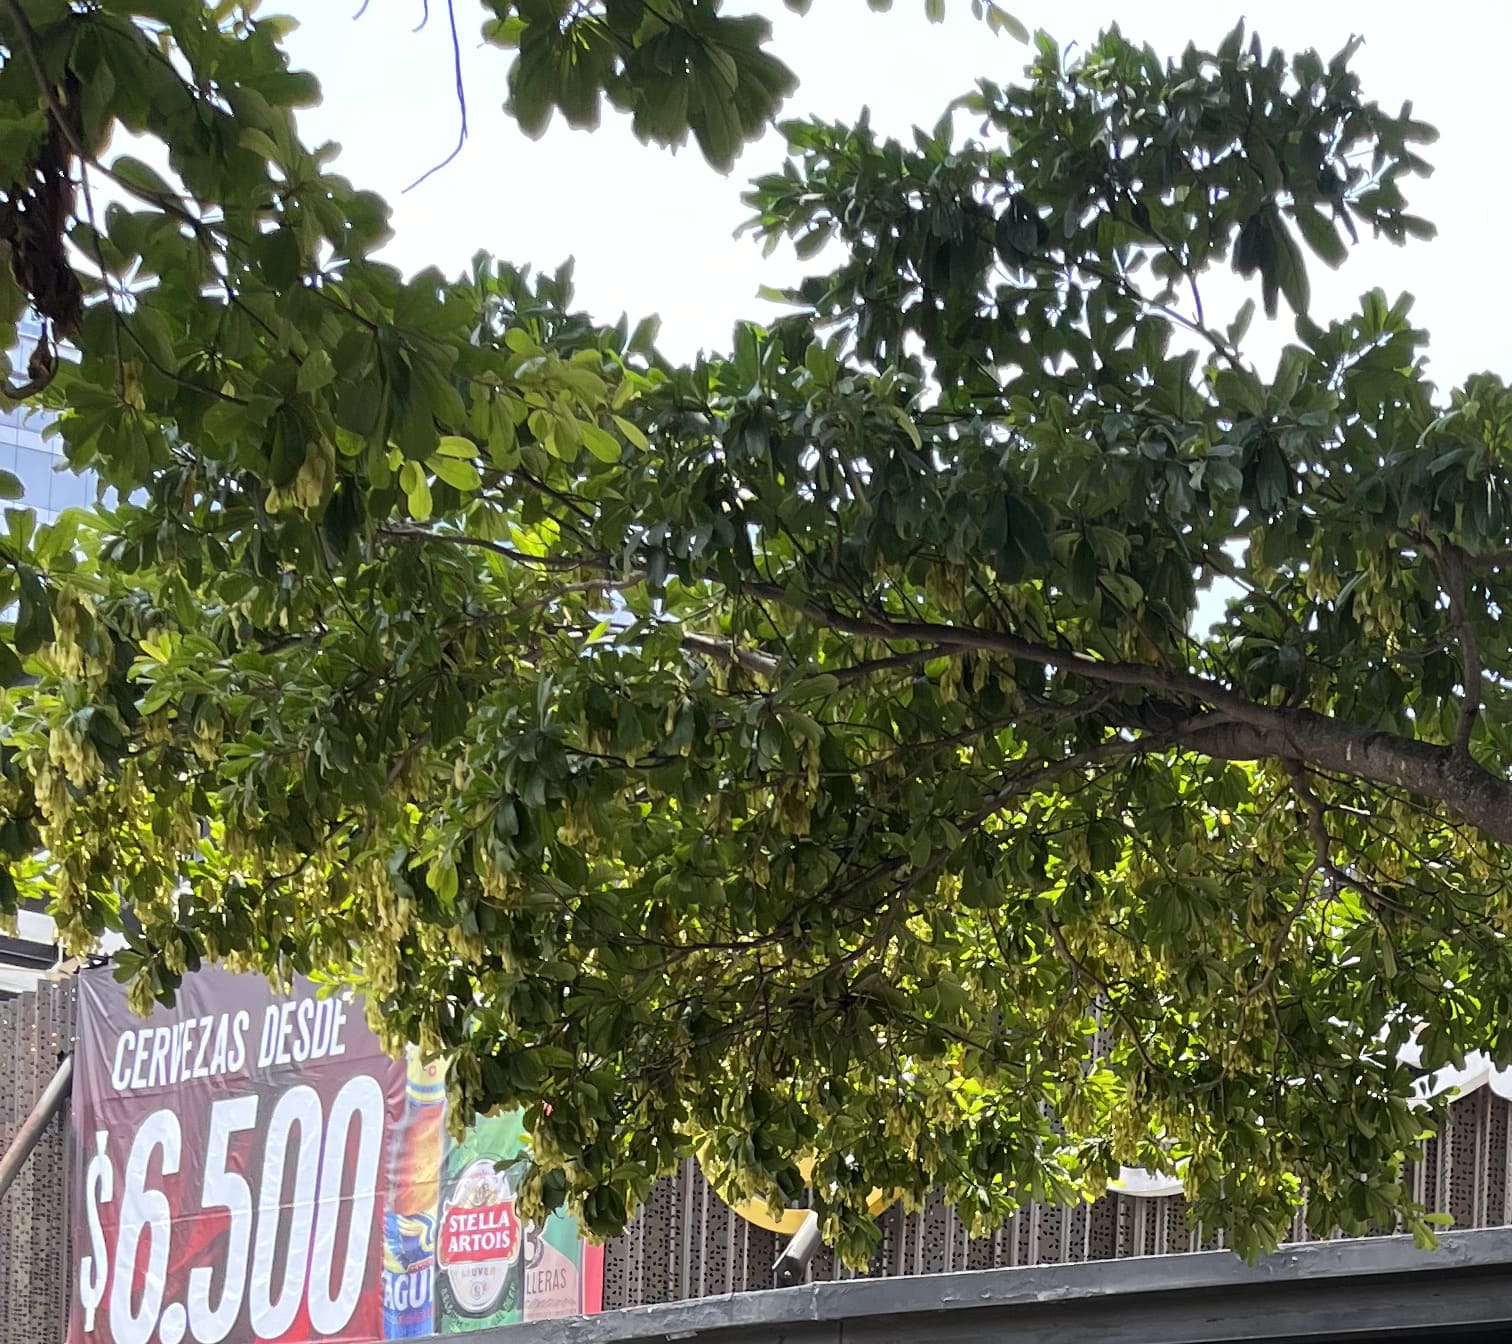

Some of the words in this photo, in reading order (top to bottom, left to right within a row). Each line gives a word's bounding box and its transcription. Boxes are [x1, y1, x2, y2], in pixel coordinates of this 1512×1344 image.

[111, 1010, 249, 1091] CERVEZAS
[257, 992, 354, 1068] DESDE
[450, 1210, 510, 1232] STELLA
[448, 1230, 510, 1253] ARTOIS
